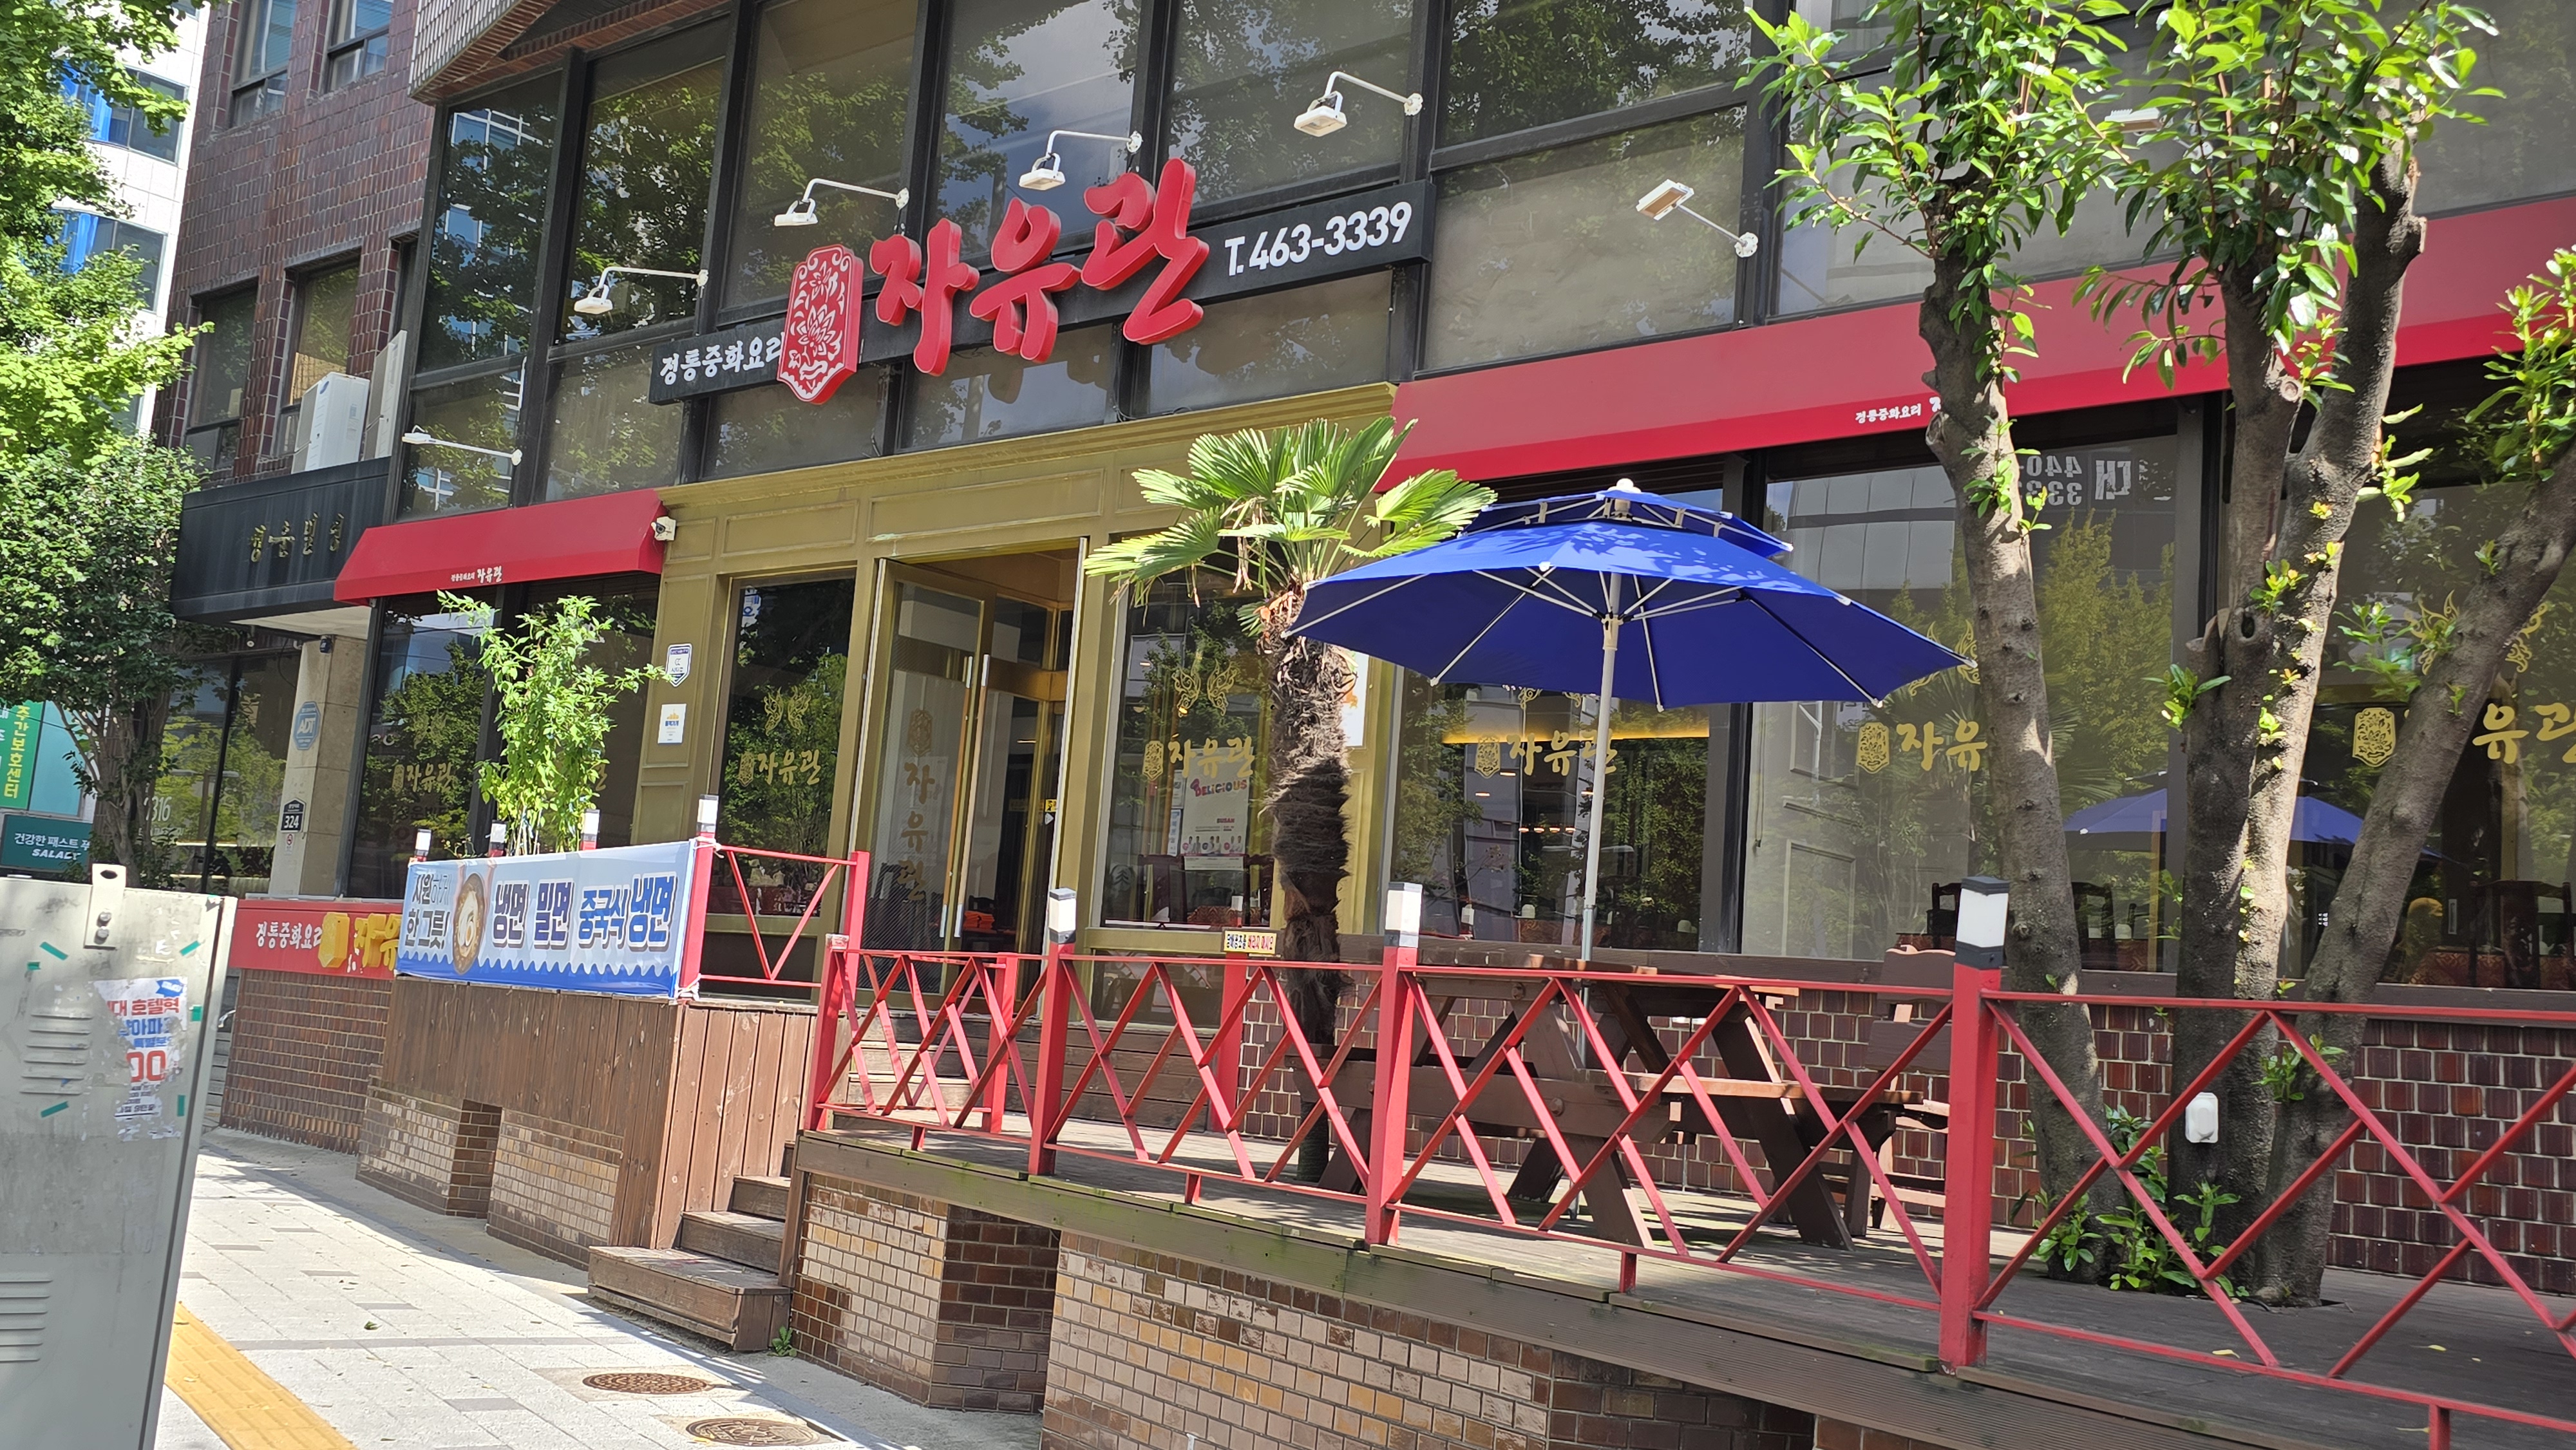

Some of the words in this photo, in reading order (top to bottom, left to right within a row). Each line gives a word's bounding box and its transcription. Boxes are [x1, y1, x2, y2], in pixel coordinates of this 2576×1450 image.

[869, 158, 1209, 377] 자유관
[660, 332, 785, 385] 정통중화요리
[1855, 403, 1921, 424] 정통중화요리
[477, 565, 502, 583] 자유관
[296, 717, 316, 734] ADT
[4, 705, 30, 798] 주간보호센터
[1168, 736, 1255, 778] 자유관
[1896, 719, 1988, 771] 자유
[406, 762, 452, 793] 자유관
[757, 749, 822, 786] 자유관
[1195, 780, 1248, 797] DELICIOUS
[284, 815, 299, 829] 324
[898, 762, 936, 901] 자유관
[15, 833, 46, 847] 건강한
[48, 836, 79, 849] 패스트
[412, 874, 452, 905] 시원하게
[405, 909, 420, 947] 한
[493, 882, 530, 948] 냉면
[533, 881, 574, 950] 밀면
[354, 913, 402, 972] 자유
